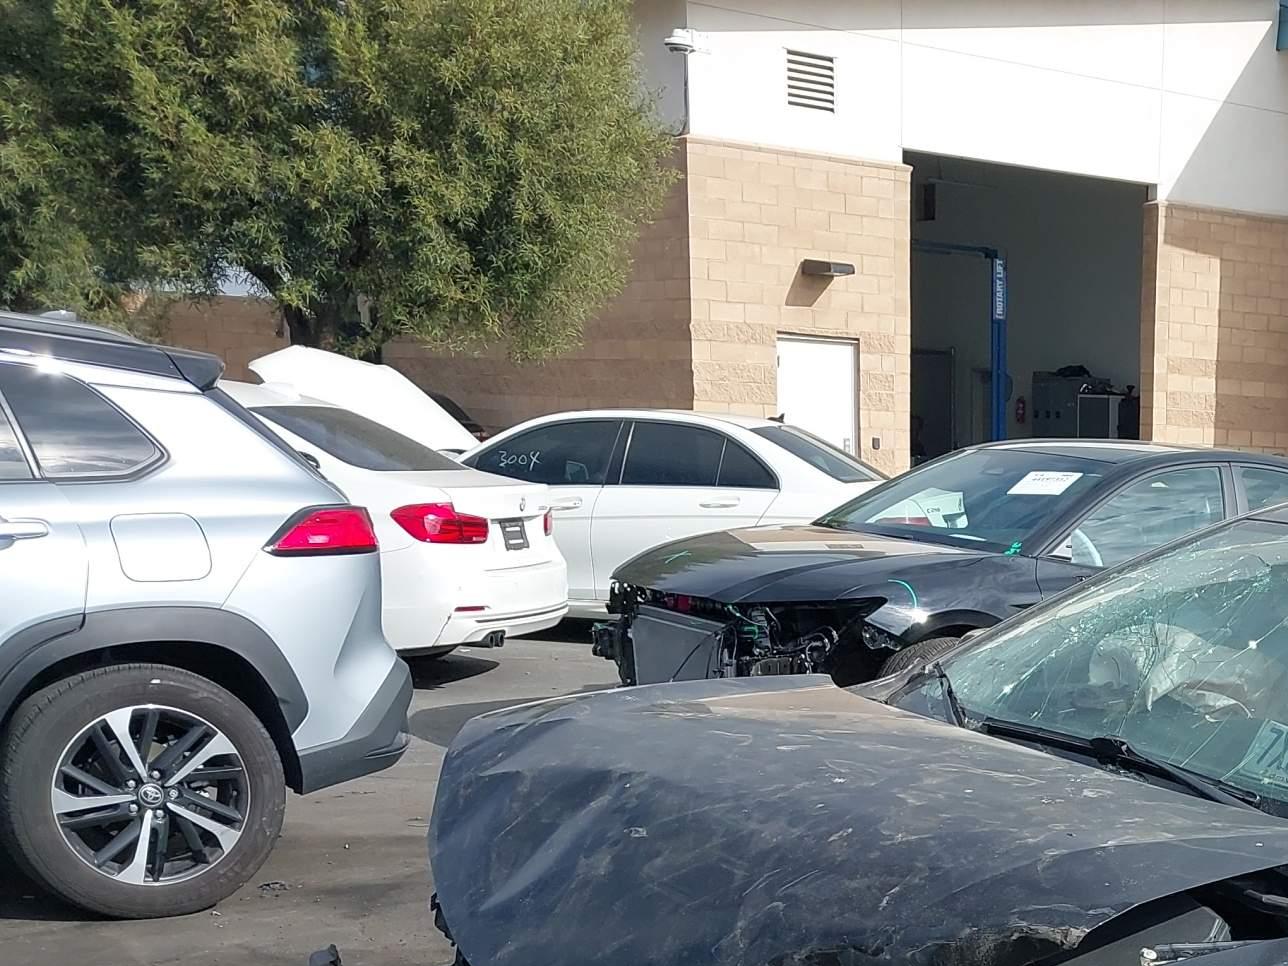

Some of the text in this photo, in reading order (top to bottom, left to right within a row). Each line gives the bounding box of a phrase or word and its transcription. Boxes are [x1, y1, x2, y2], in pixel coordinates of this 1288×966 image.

[996, 259, 1004, 315] ROTARY LIFT
[498, 450, 542, 472] 3004
